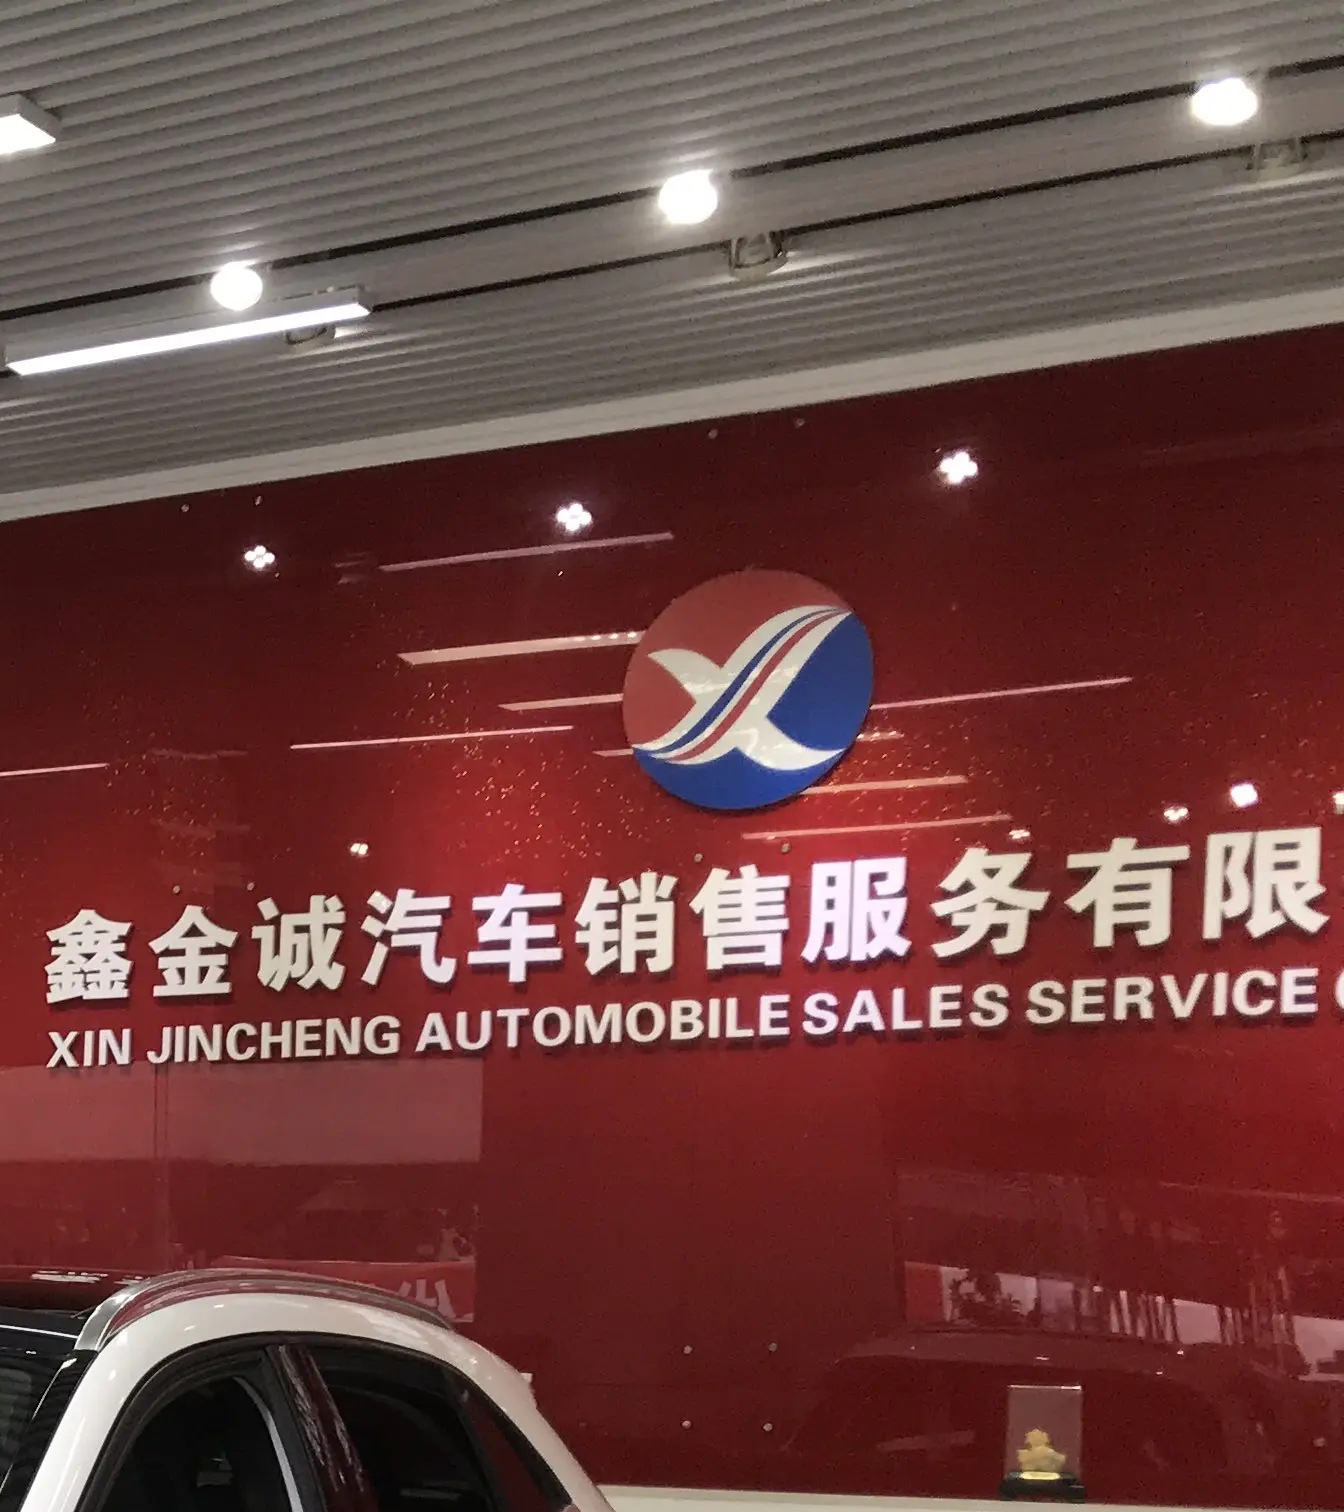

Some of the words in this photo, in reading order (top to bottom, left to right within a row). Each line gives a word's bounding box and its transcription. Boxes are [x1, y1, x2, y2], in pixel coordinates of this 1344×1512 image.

[45, 827, 1330, 1004] 鑫金诚汽车销售服务有限
[46, 1027, 131, 1069] XIN
[146, 1015, 401, 1065] JINCHENG
[415, 993, 791, 1053] AUTOMOBILE
[801, 983, 1010, 1036] SALES
[1024, 967, 1320, 1025] SERVICE
